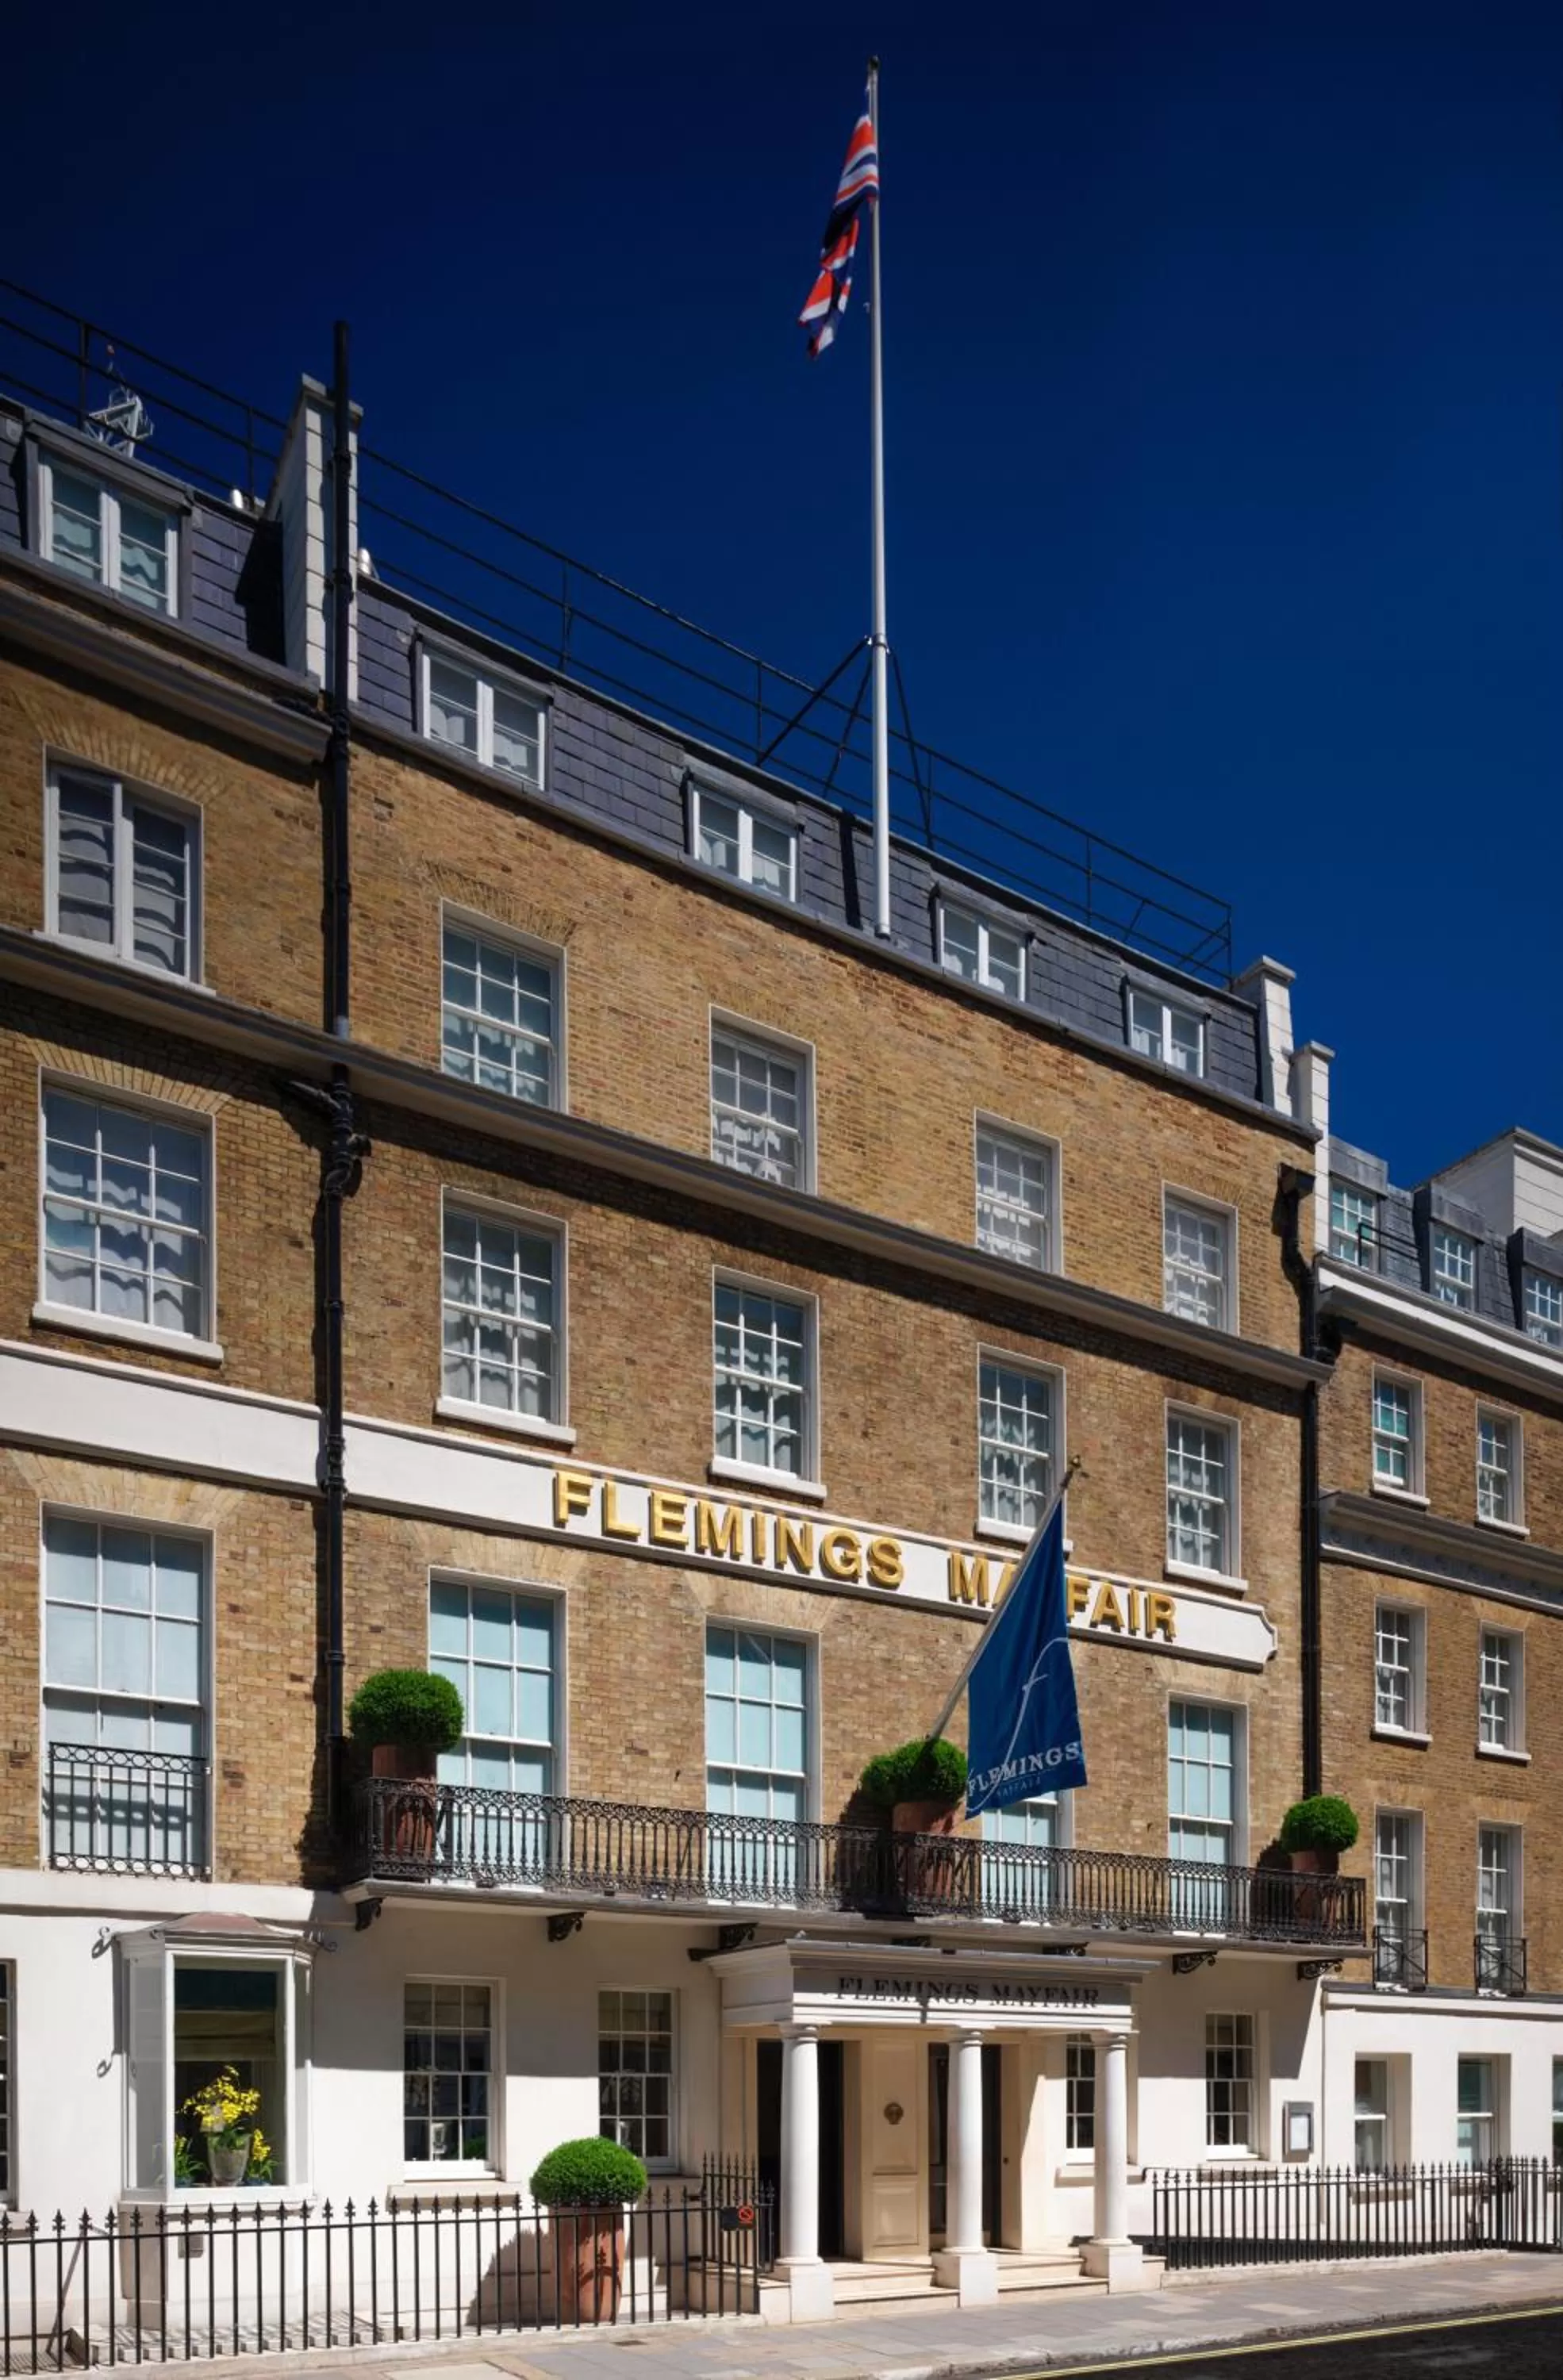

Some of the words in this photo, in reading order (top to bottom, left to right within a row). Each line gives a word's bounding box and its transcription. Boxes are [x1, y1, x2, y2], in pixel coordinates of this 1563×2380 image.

[555, 1472, 904, 1587] FLEMINGS
[950, 1551, 1177, 1638] MFAIR
[968, 1741, 1081, 1797] FLEMINGS
[837, 1977, 980, 2005] FLEMINGS
[990, 1984, 1099, 2009] MAYFAIR
